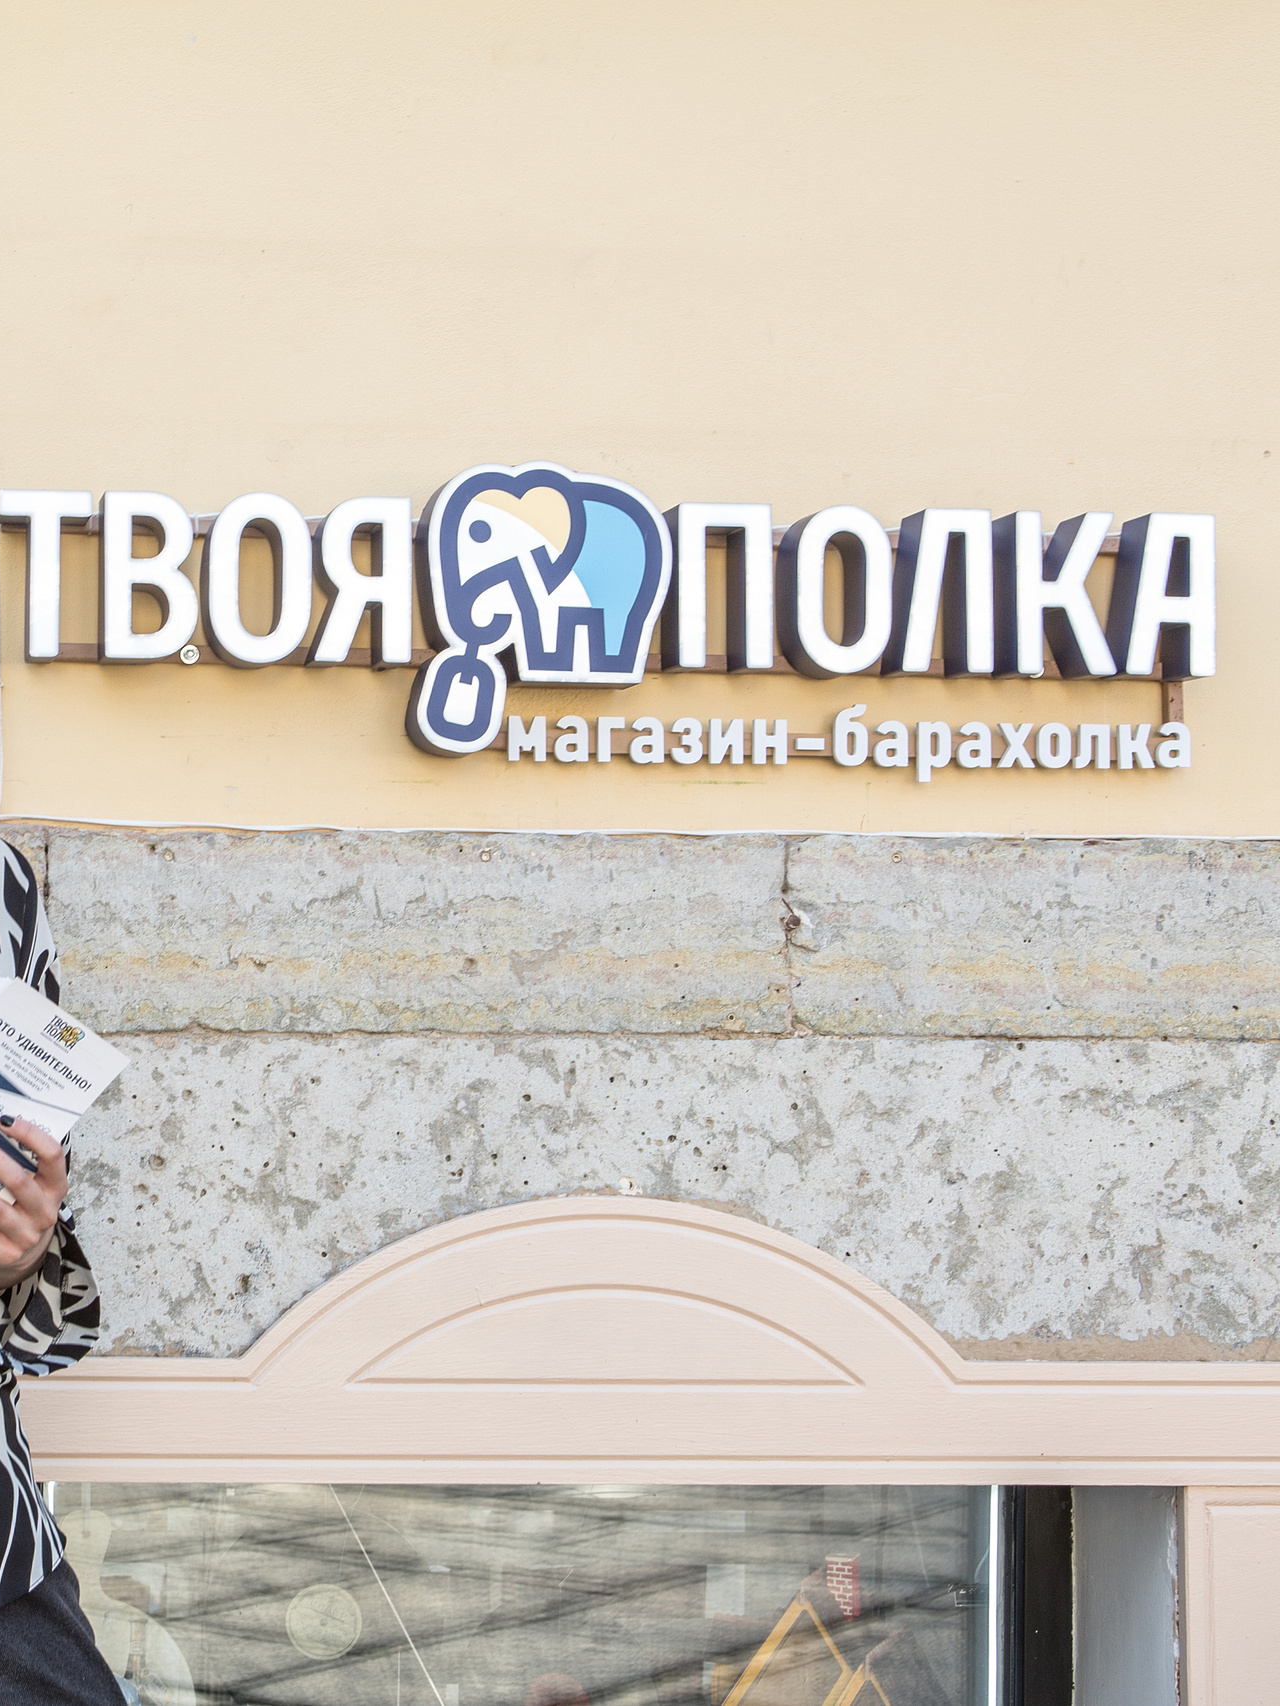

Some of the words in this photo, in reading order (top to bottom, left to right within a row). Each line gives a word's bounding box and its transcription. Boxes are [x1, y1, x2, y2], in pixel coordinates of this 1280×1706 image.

[670, 502, 1216, 680] ПОЛКА
[506, 703, 1191, 783] магазин-барахолка
[50, 1014, 73, 1035] ТВОЯ
[15, 1033, 92, 1092] УДИВИТЕЛЬНО!
